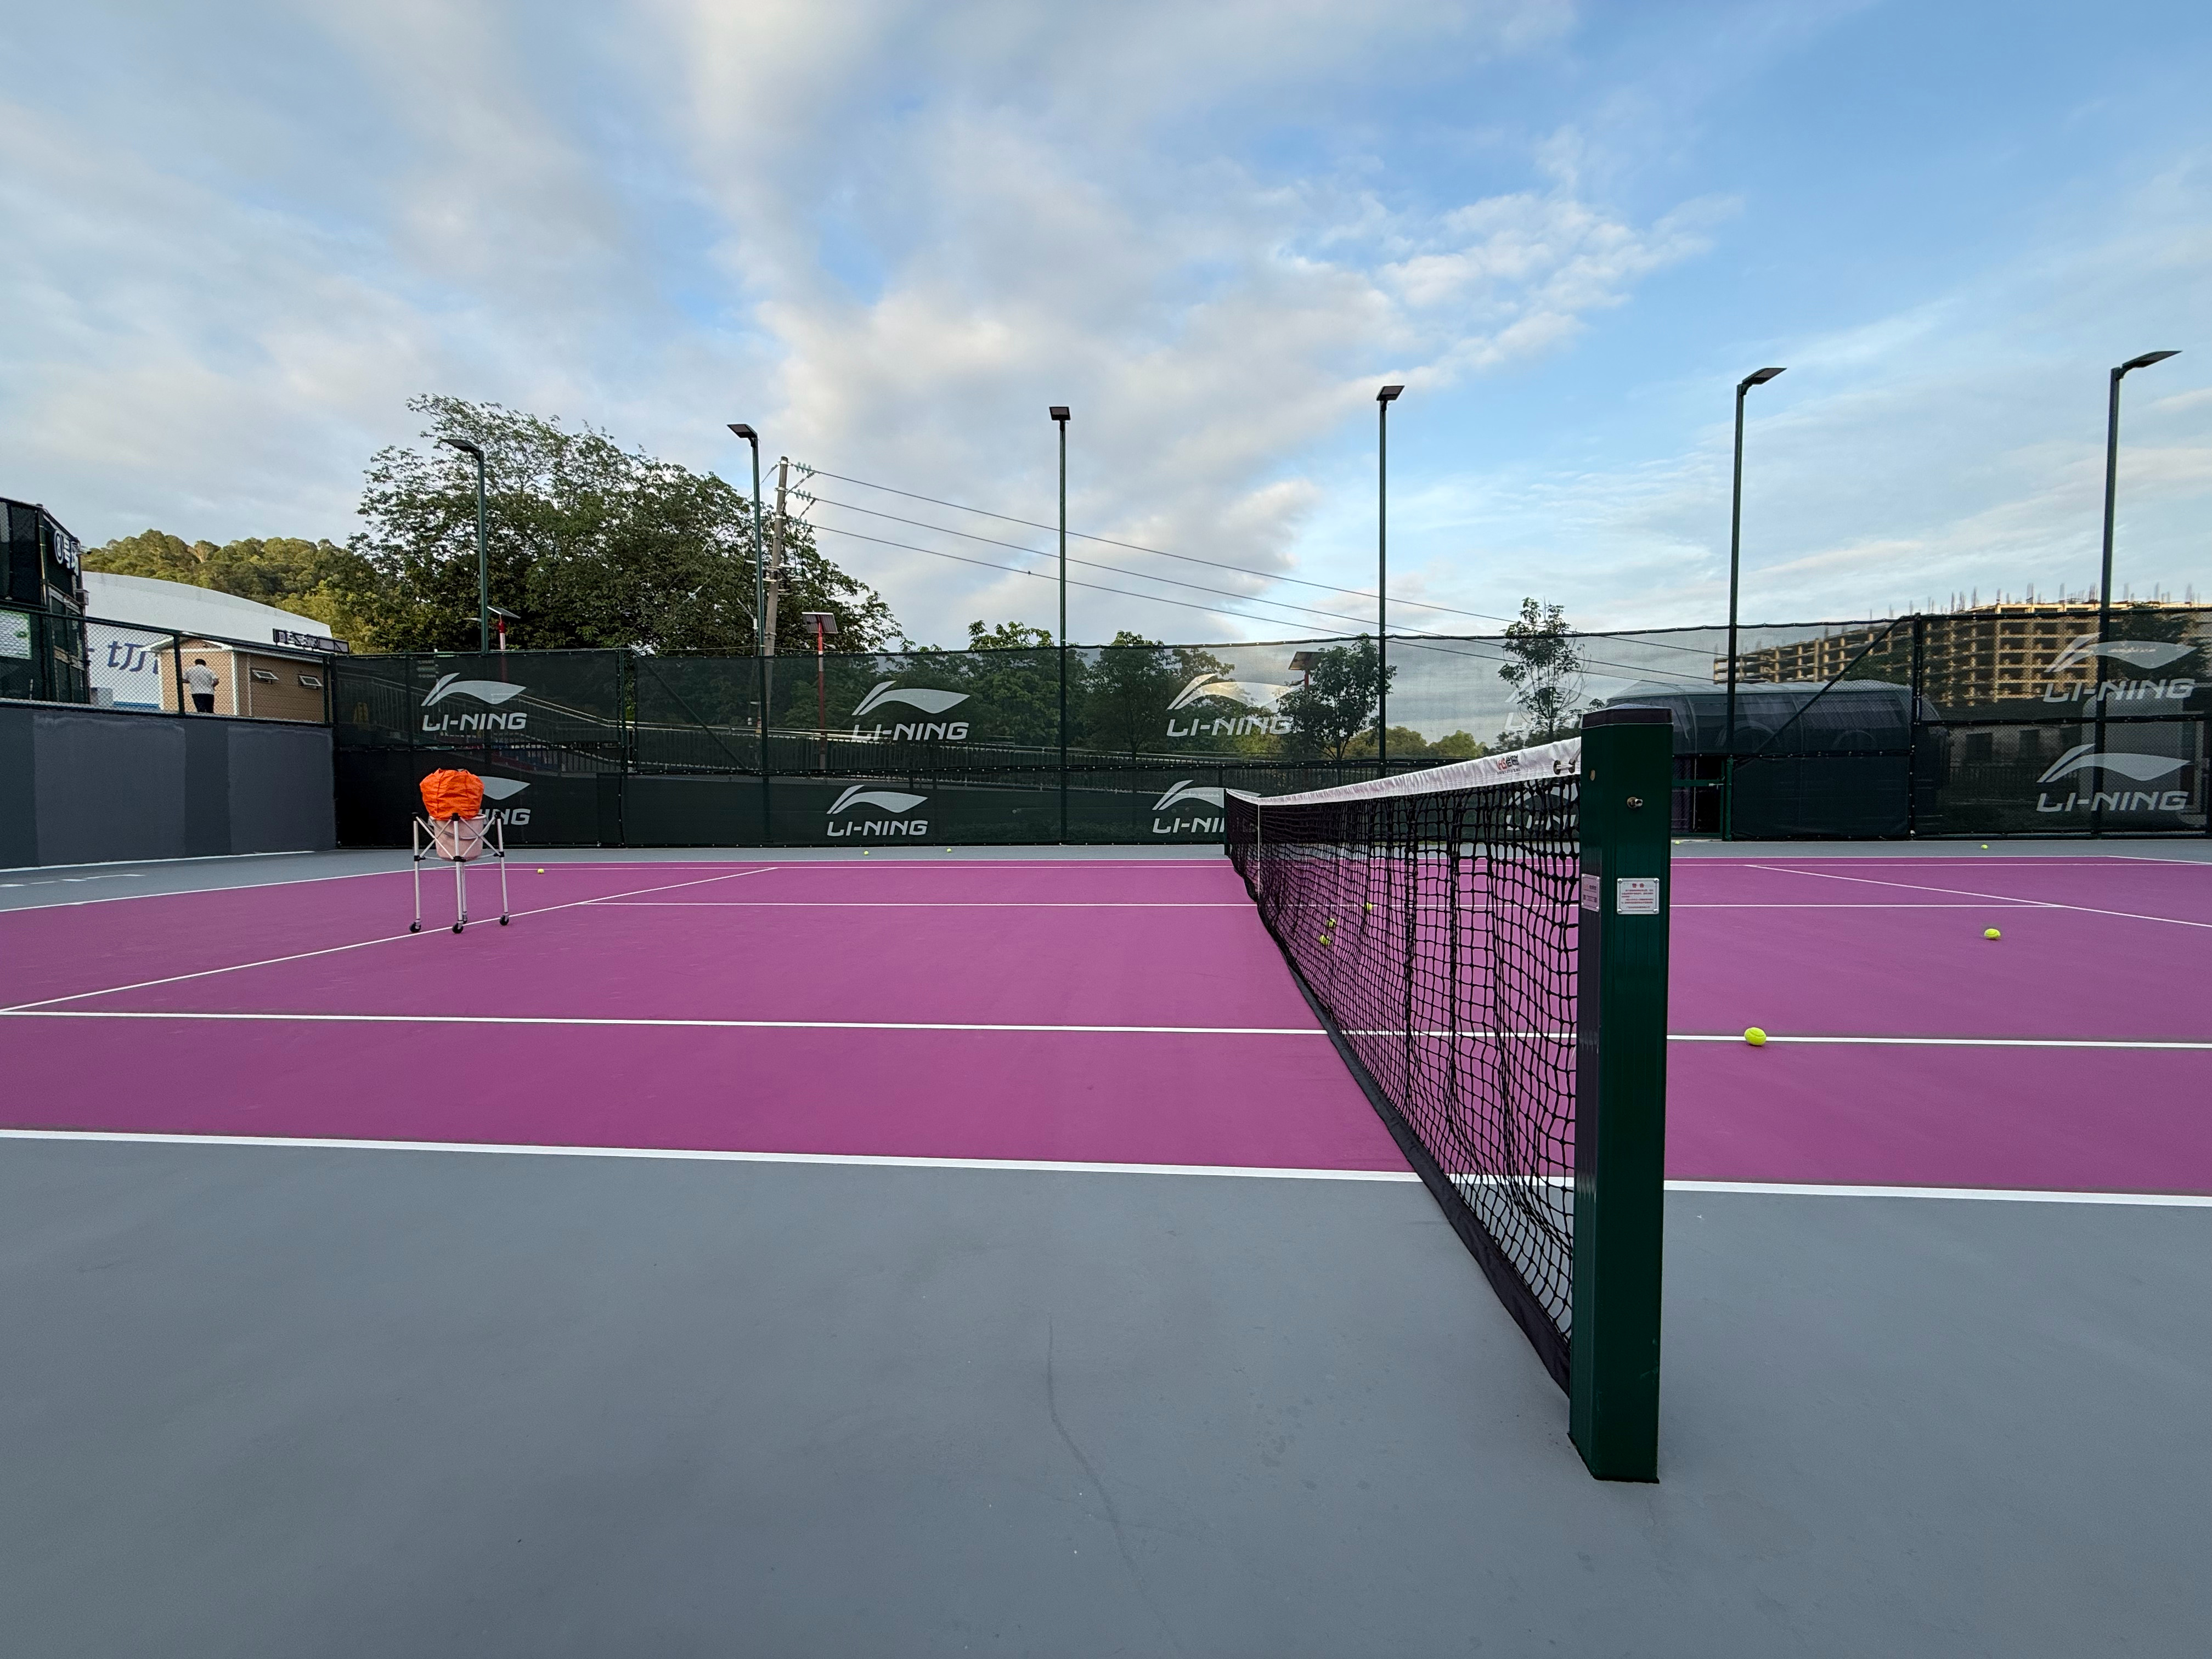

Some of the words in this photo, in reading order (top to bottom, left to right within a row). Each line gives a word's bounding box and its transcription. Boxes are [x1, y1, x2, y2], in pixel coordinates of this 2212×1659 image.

[2043, 678, 2195, 702] LI-NING
[422, 713, 527, 731] LI-NING
[851, 722, 969, 741] LI-NING
[1166, 716, 1293, 737] LI-NING
[2036, 791, 2188, 812] LI-NING
[827, 820, 928, 836] LI-NING
[1152, 817, 1224, 833] LI-NI
